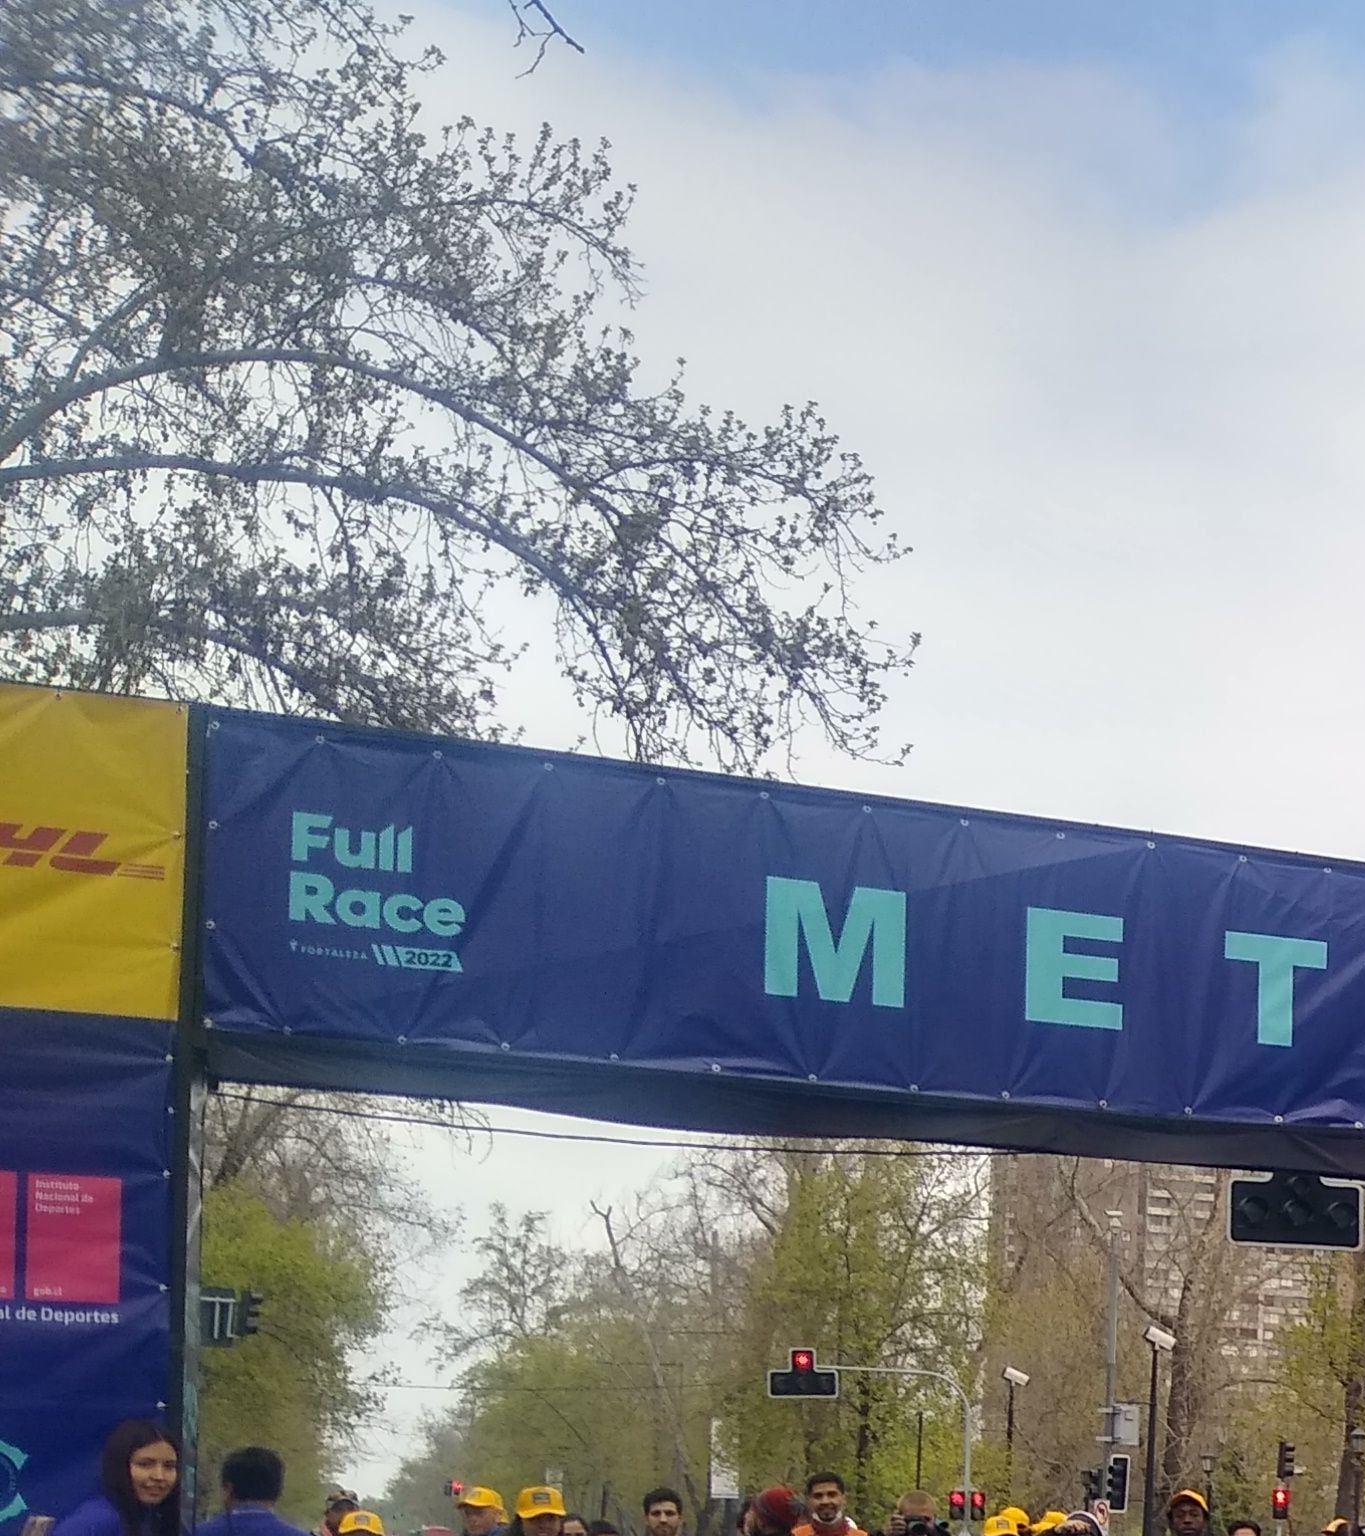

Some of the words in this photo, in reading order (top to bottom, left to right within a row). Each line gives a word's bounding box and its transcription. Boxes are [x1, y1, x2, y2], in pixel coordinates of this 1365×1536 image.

[291, 811, 414, 874] Full
[288, 870, 466, 937] Race
[404, 950, 453, 968] 2022
[16, 1306, 37, 1322] de
[41, 1307, 120, 1326] Deportes
